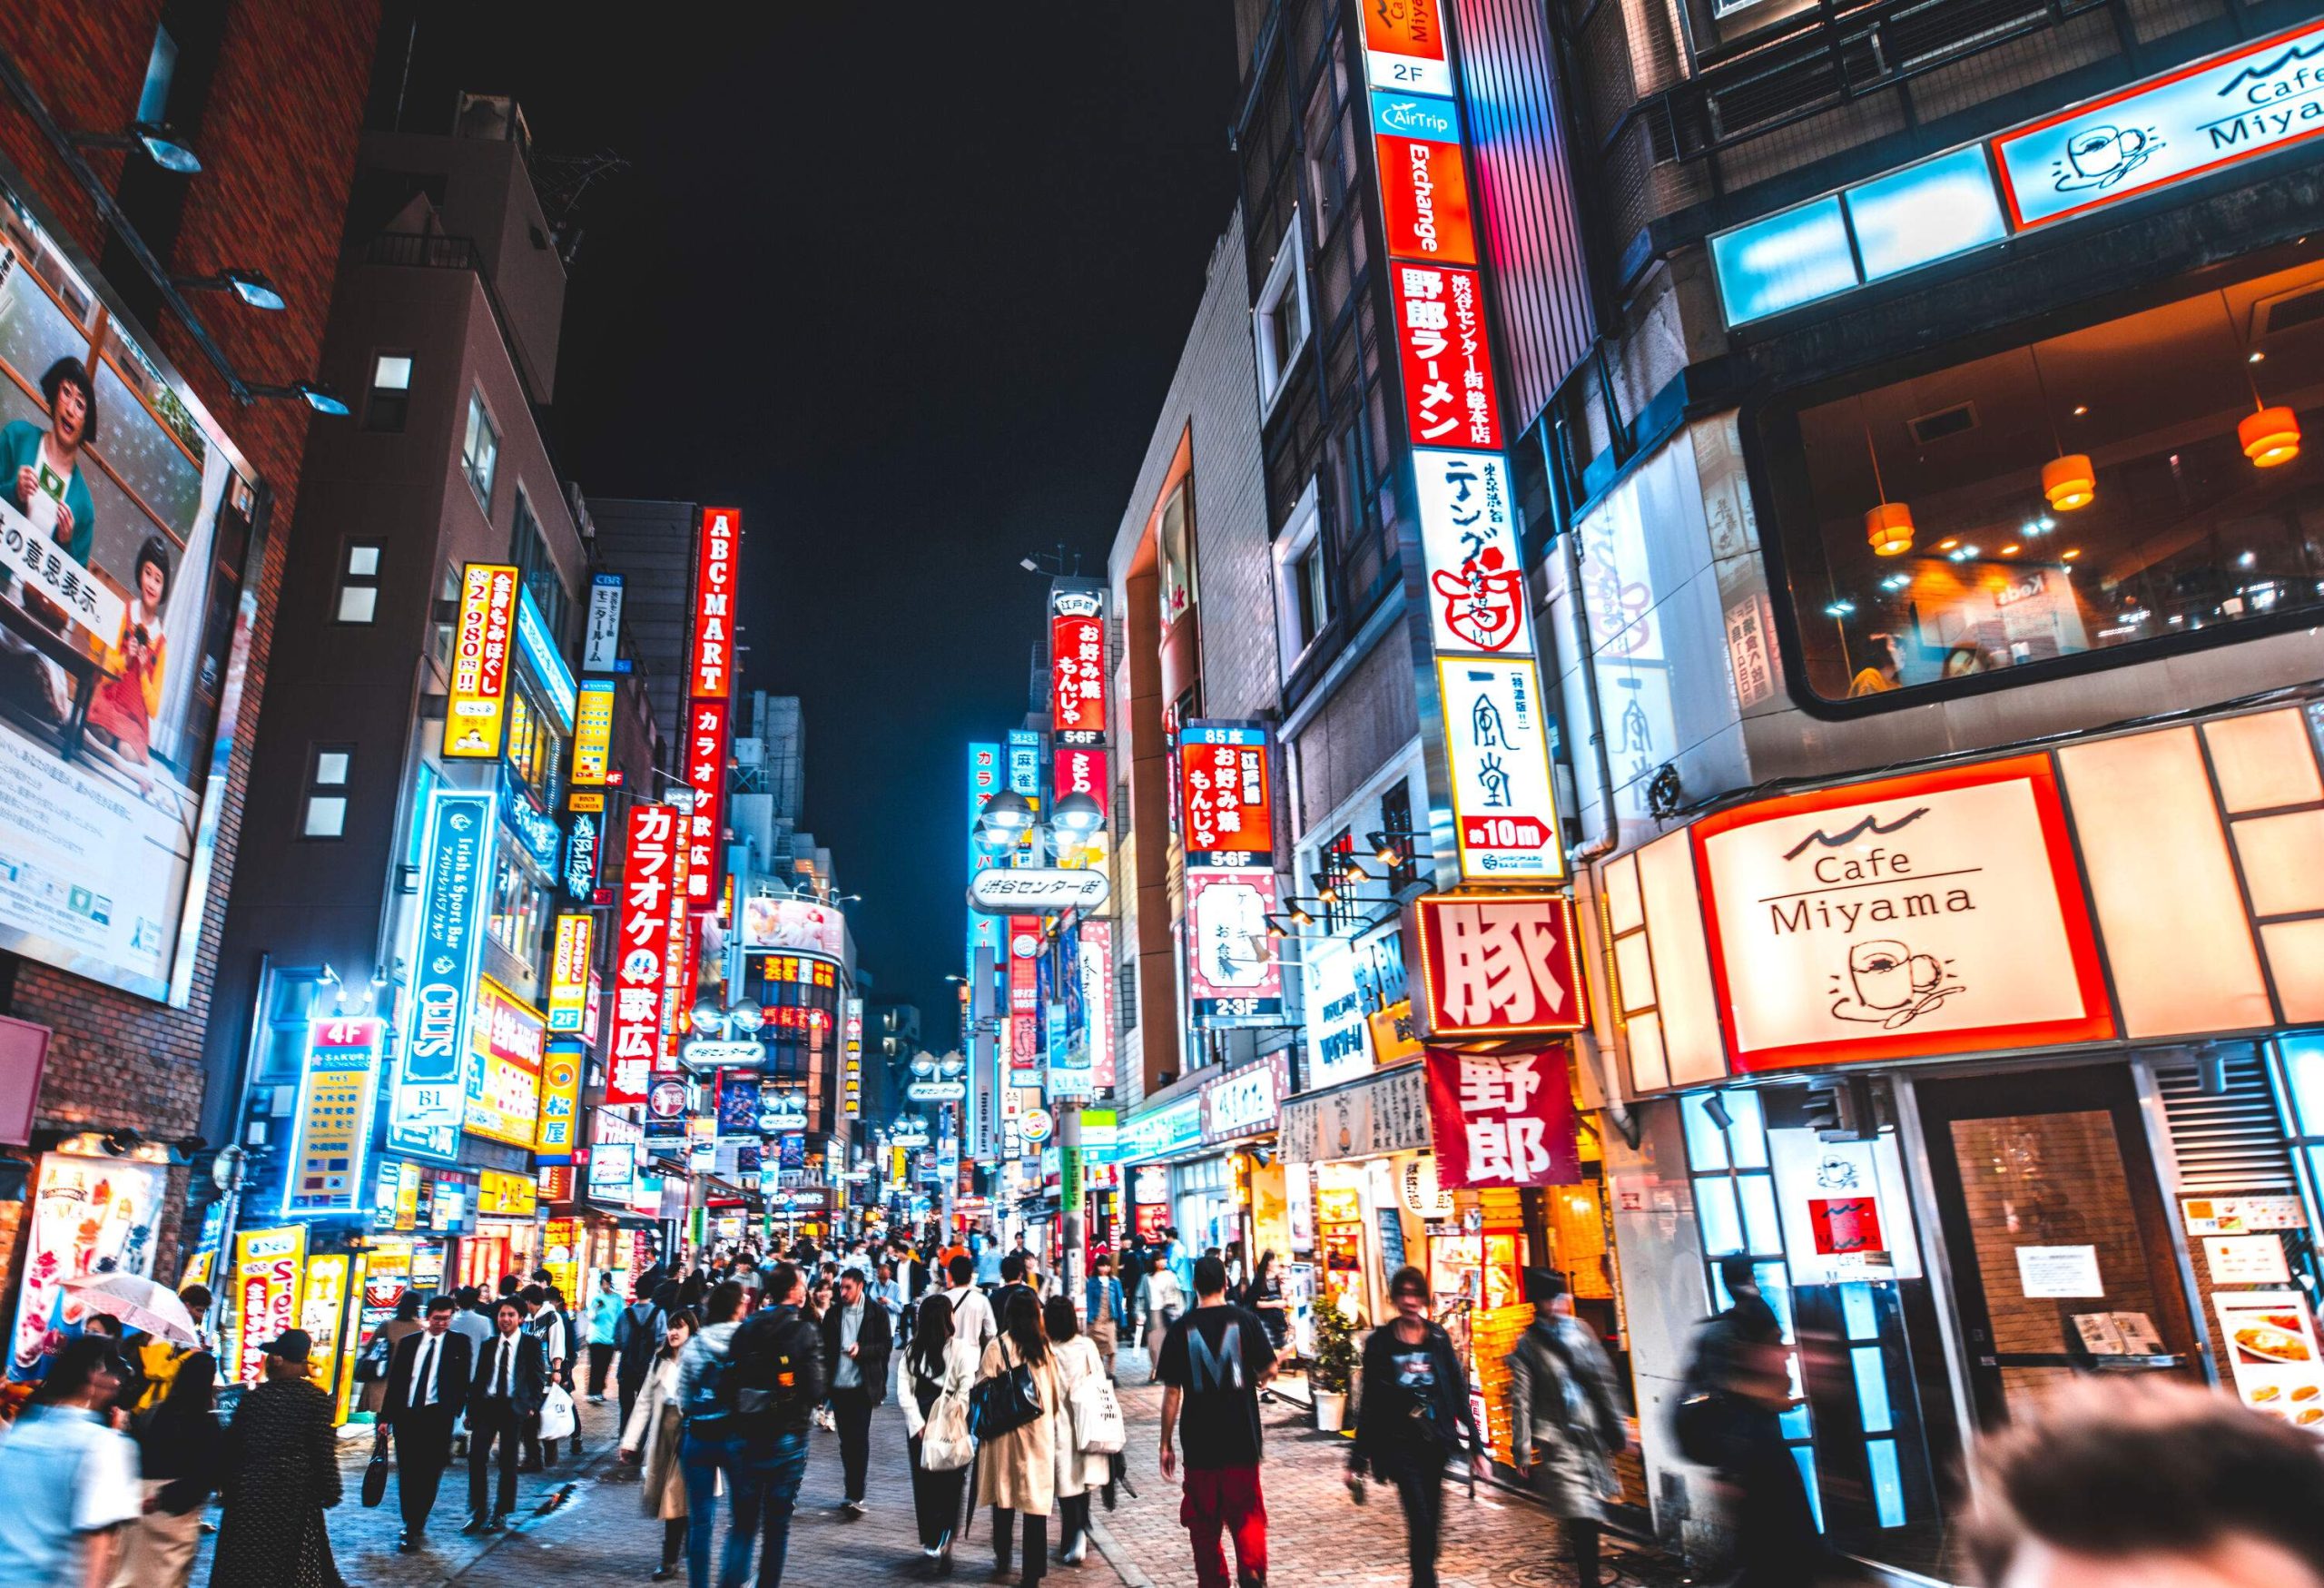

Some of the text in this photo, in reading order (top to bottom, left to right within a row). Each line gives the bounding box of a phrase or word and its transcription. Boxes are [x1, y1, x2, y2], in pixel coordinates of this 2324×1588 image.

[1393, 64, 1423, 82] 2F
[2247, 67, 2324, 104] Cafe
[1394, 111, 1448, 133] AirTrip
[1409, 143, 1438, 252] Exchange
[1402, 268, 1459, 439] 野郎ラーメン
[596, 575, 621, 585] CBR
[482, 574, 511, 694] 全身もみほぐし
[1078, 625, 1101, 699] お好み焼
[1059, 656, 1080, 725] もんじゃ
[1017, 754, 1031, 788] 麻雀
[1467, 670, 1521, 807] 一風堂
[606, 774, 622, 784] 4F
[689, 712, 718, 895] カラオケ歌広場
[1189, 770, 1216, 847] もんじゃ
[1214, 747, 1241, 832] お好み焼
[1241, 752, 1261, 804] 江戸前
[447, 838, 474, 949] Irish & Sport Bar
[625, 807, 672, 946] カラオケ
[980, 879, 1101, 894] 渋谷センター街
[1816, 847, 1911, 883] Cafe
[1769, 887, 1975, 935] Miyama
[1438, 902, 1565, 1027] 豚
[328, 1022, 363, 1043] 4F
[414, 983, 458, 1057] CELTS
[555, 1012, 577, 1026] 2F
[419, 1090, 441, 1106] B1
[545, 1095, 571, 1143] 松屋
[1458, 1053, 1551, 1184] 野郎
[1187, 1322, 1244, 1393] M
